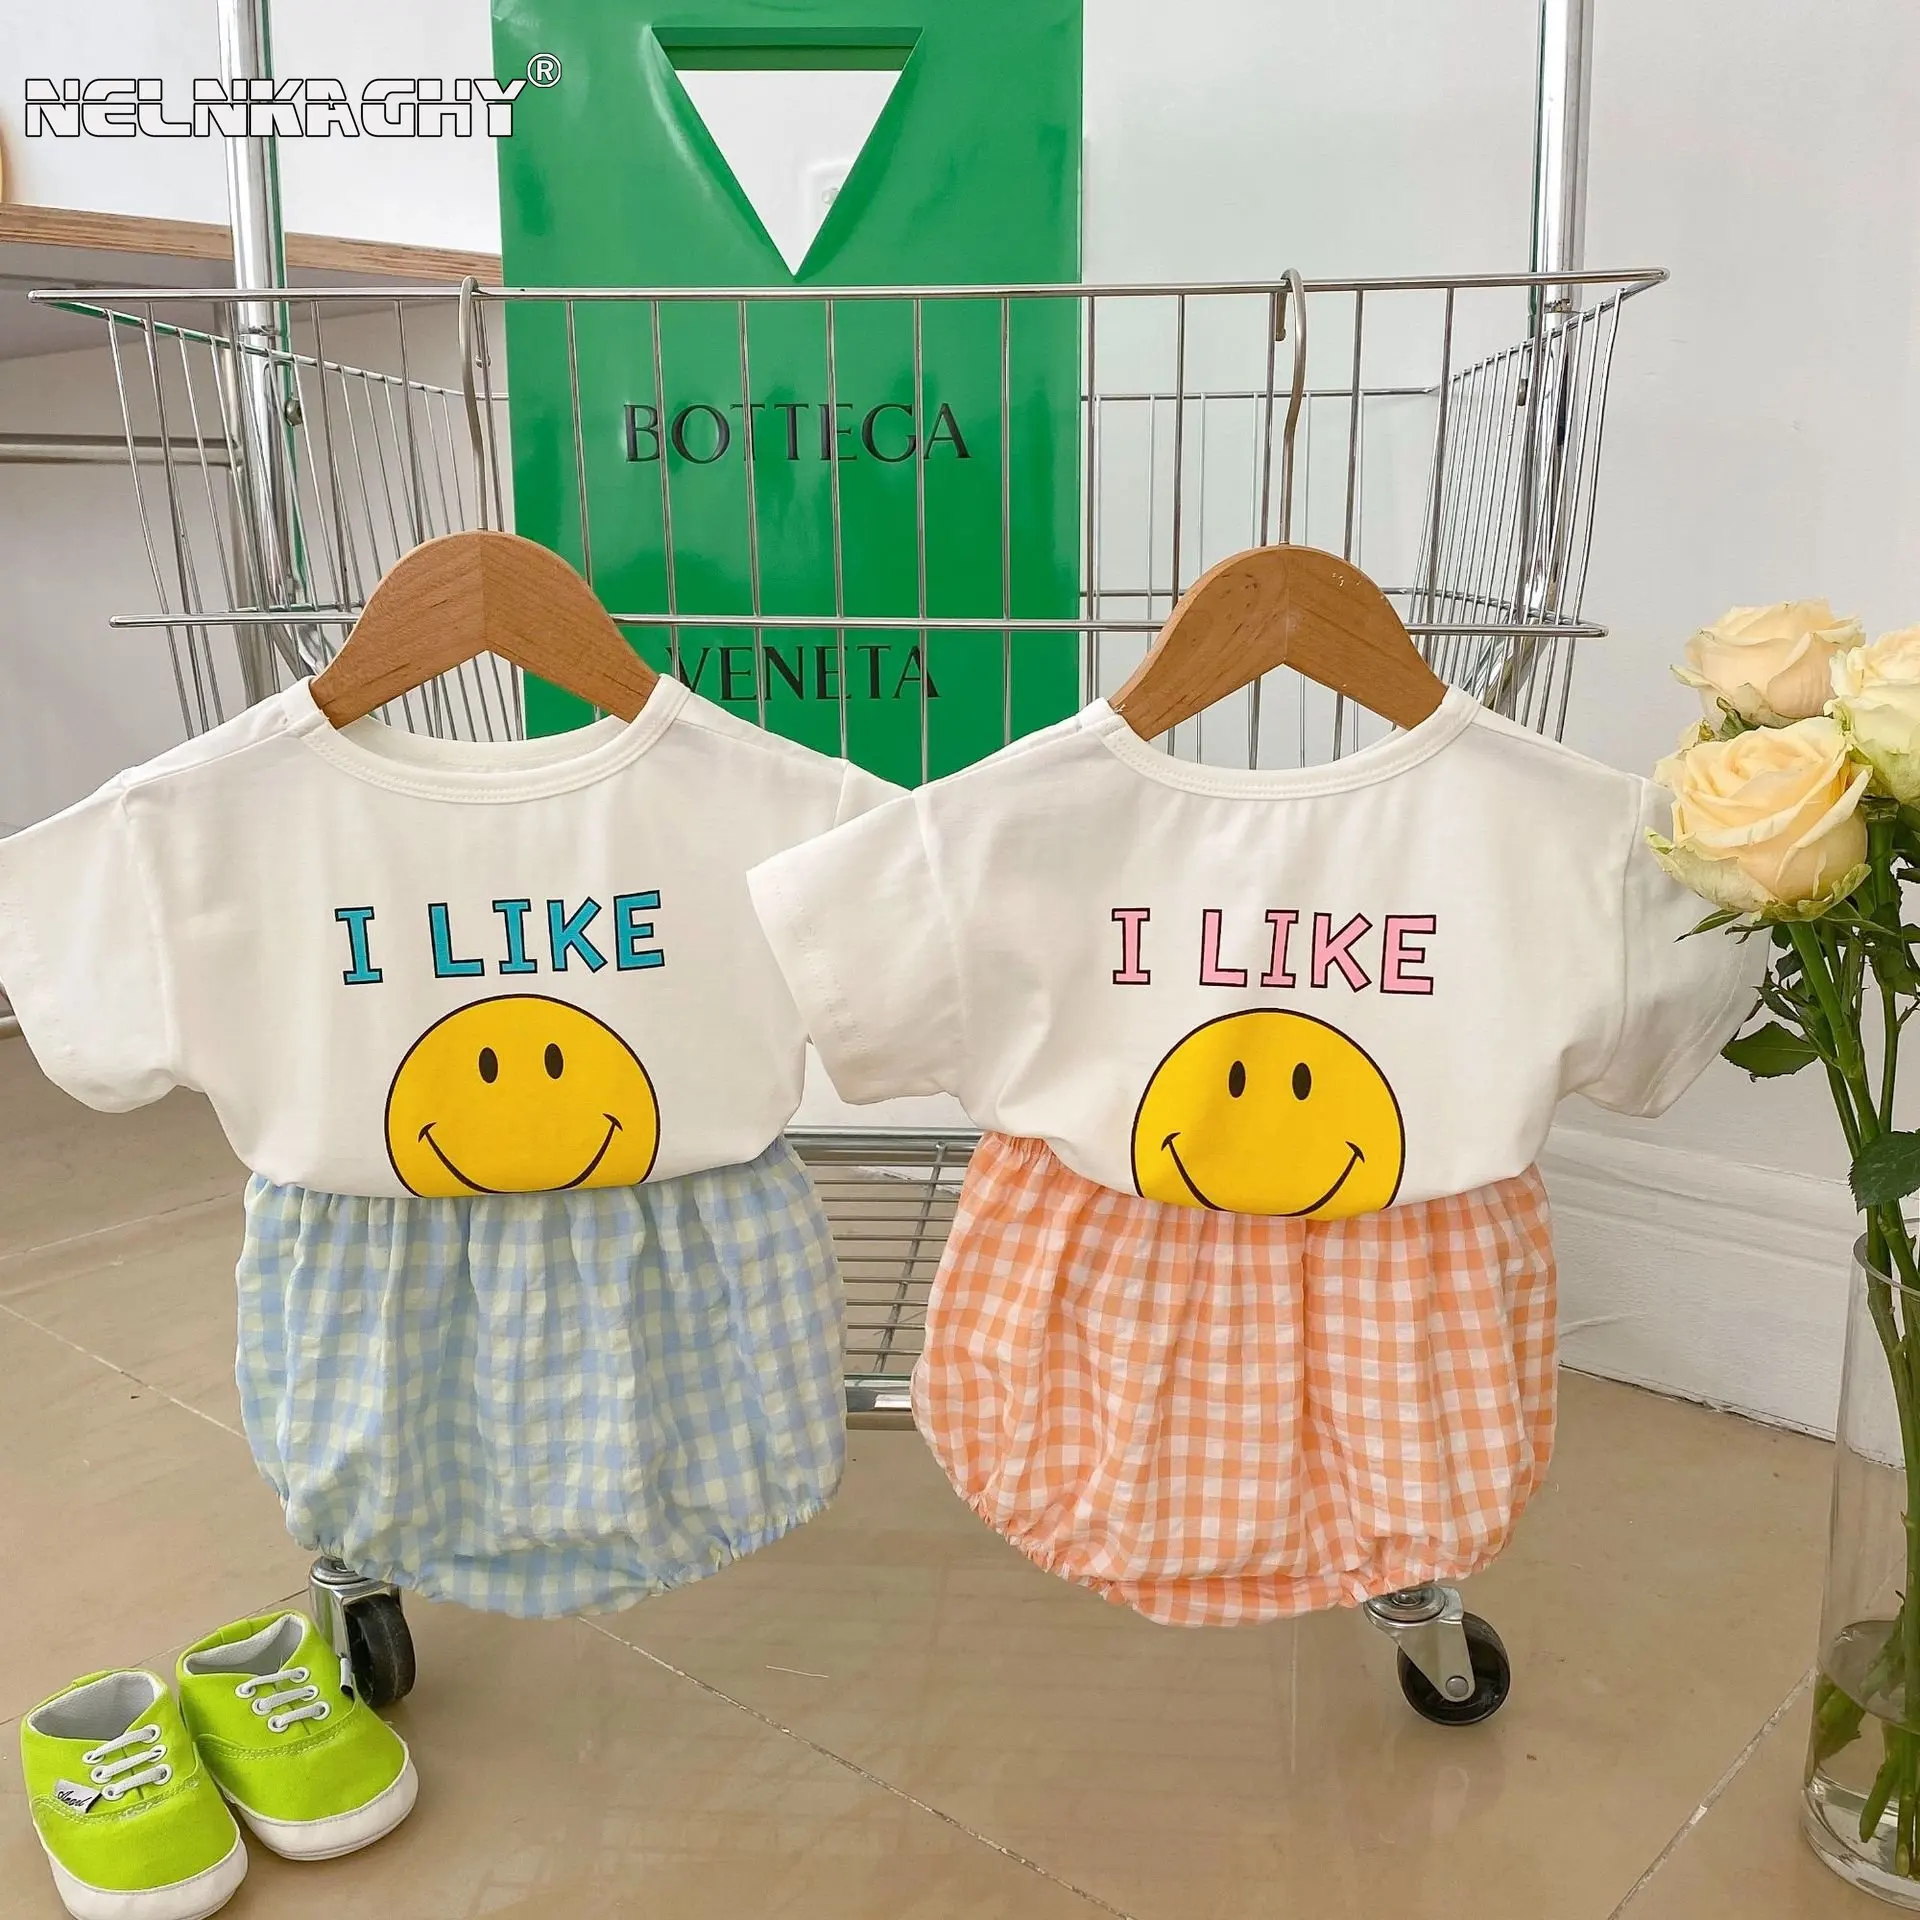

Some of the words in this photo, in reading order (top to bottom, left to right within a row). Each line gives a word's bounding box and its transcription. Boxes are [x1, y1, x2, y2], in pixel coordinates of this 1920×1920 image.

[623, 402, 972, 464] BOTTEGA
[665, 645, 941, 701] VENETA
[334, 906, 384, 985] I
[428, 889, 666, 979] LIKE
[1111, 907, 1151, 985] I
[1199, 908, 1437, 995] LIKE
